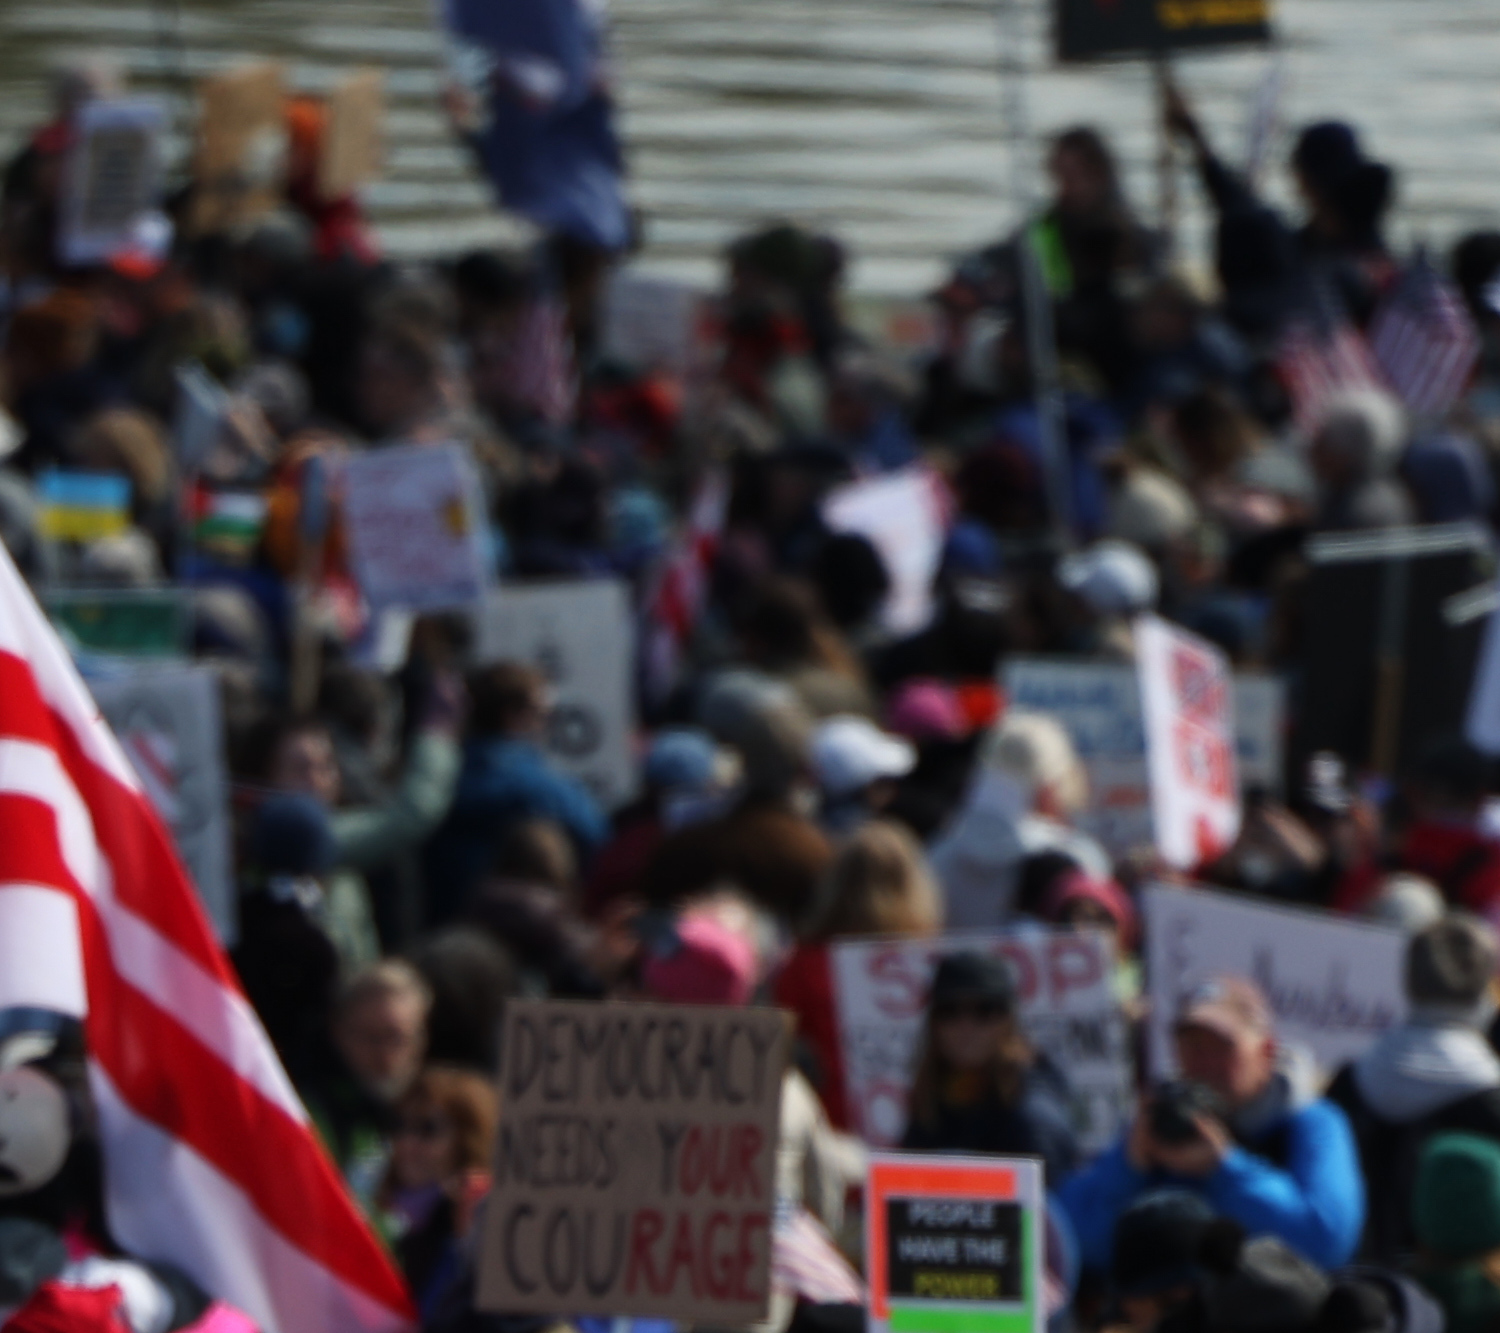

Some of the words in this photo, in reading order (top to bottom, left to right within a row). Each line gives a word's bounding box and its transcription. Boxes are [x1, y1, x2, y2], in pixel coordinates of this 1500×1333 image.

[866, 941, 1102, 1022] SOP
[503, 1014, 780, 1108] DEMOCRACY
[502, 1113, 618, 1192] NEEDS
[652, 1119, 766, 1199] YOUR
[505, 1204, 770, 1305] COURAGE
[907, 1201, 995, 1228] PEOPLE
